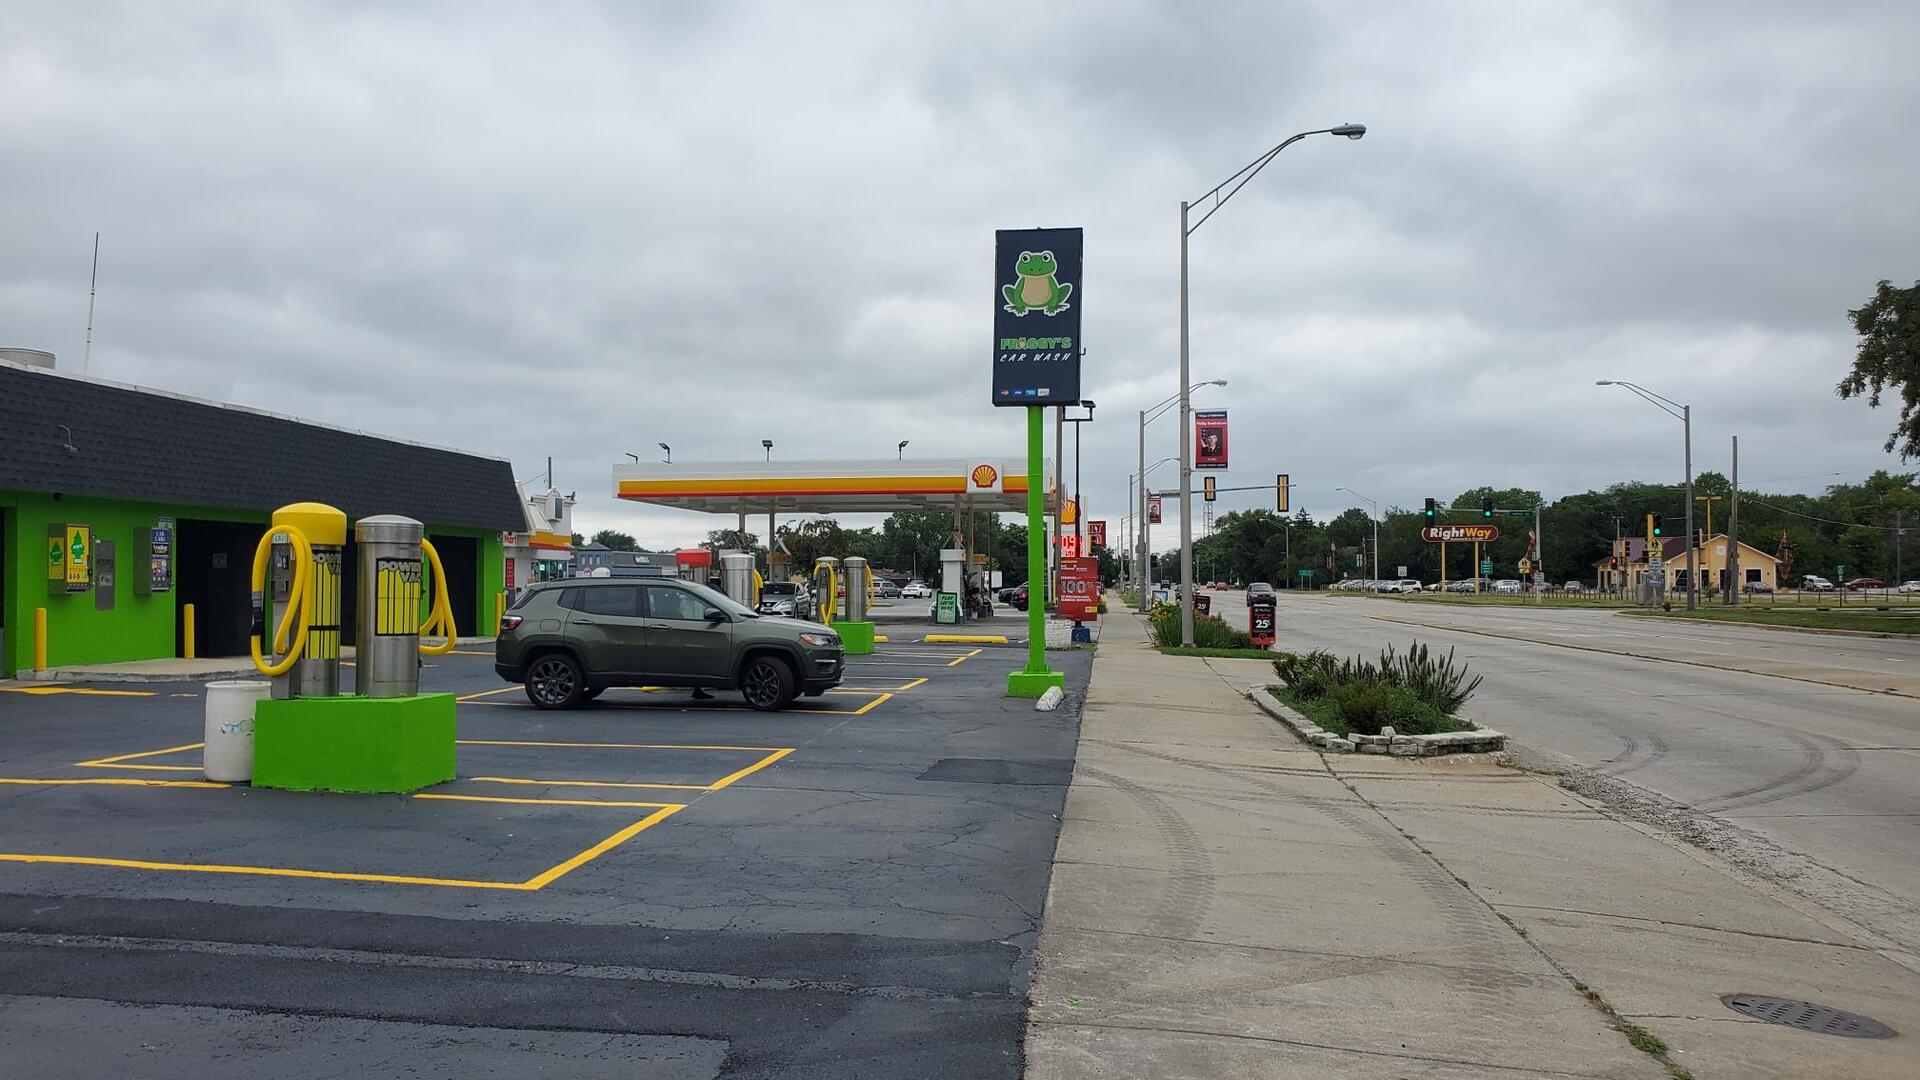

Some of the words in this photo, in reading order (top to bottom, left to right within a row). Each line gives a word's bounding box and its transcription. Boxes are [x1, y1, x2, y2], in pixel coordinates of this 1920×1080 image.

[1000, 353, 1027, 362] CAR
[1033, 352, 1071, 362] WASH
[1430, 527, 1491, 540] RightWay
